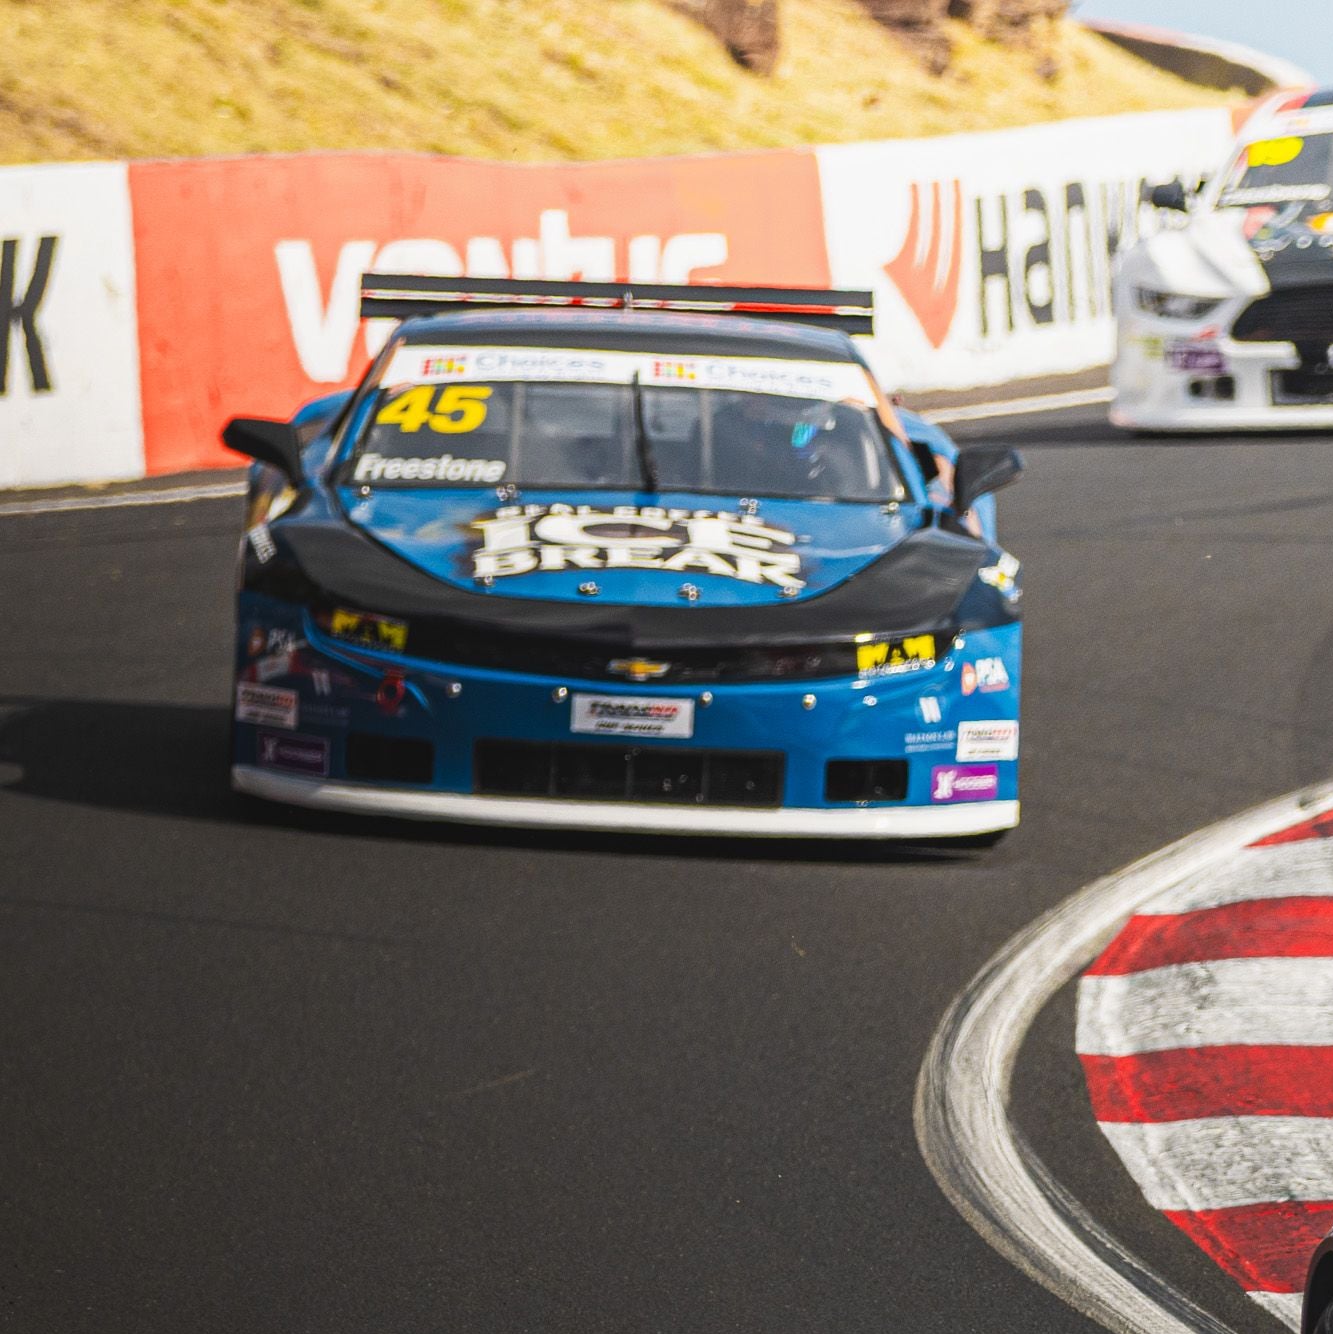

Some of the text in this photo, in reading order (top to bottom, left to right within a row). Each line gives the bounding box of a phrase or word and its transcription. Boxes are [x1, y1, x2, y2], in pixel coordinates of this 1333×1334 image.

[376, 386, 493, 434] 45
[354, 453, 507, 483] Freestone
[471, 513, 798, 560] ICE
